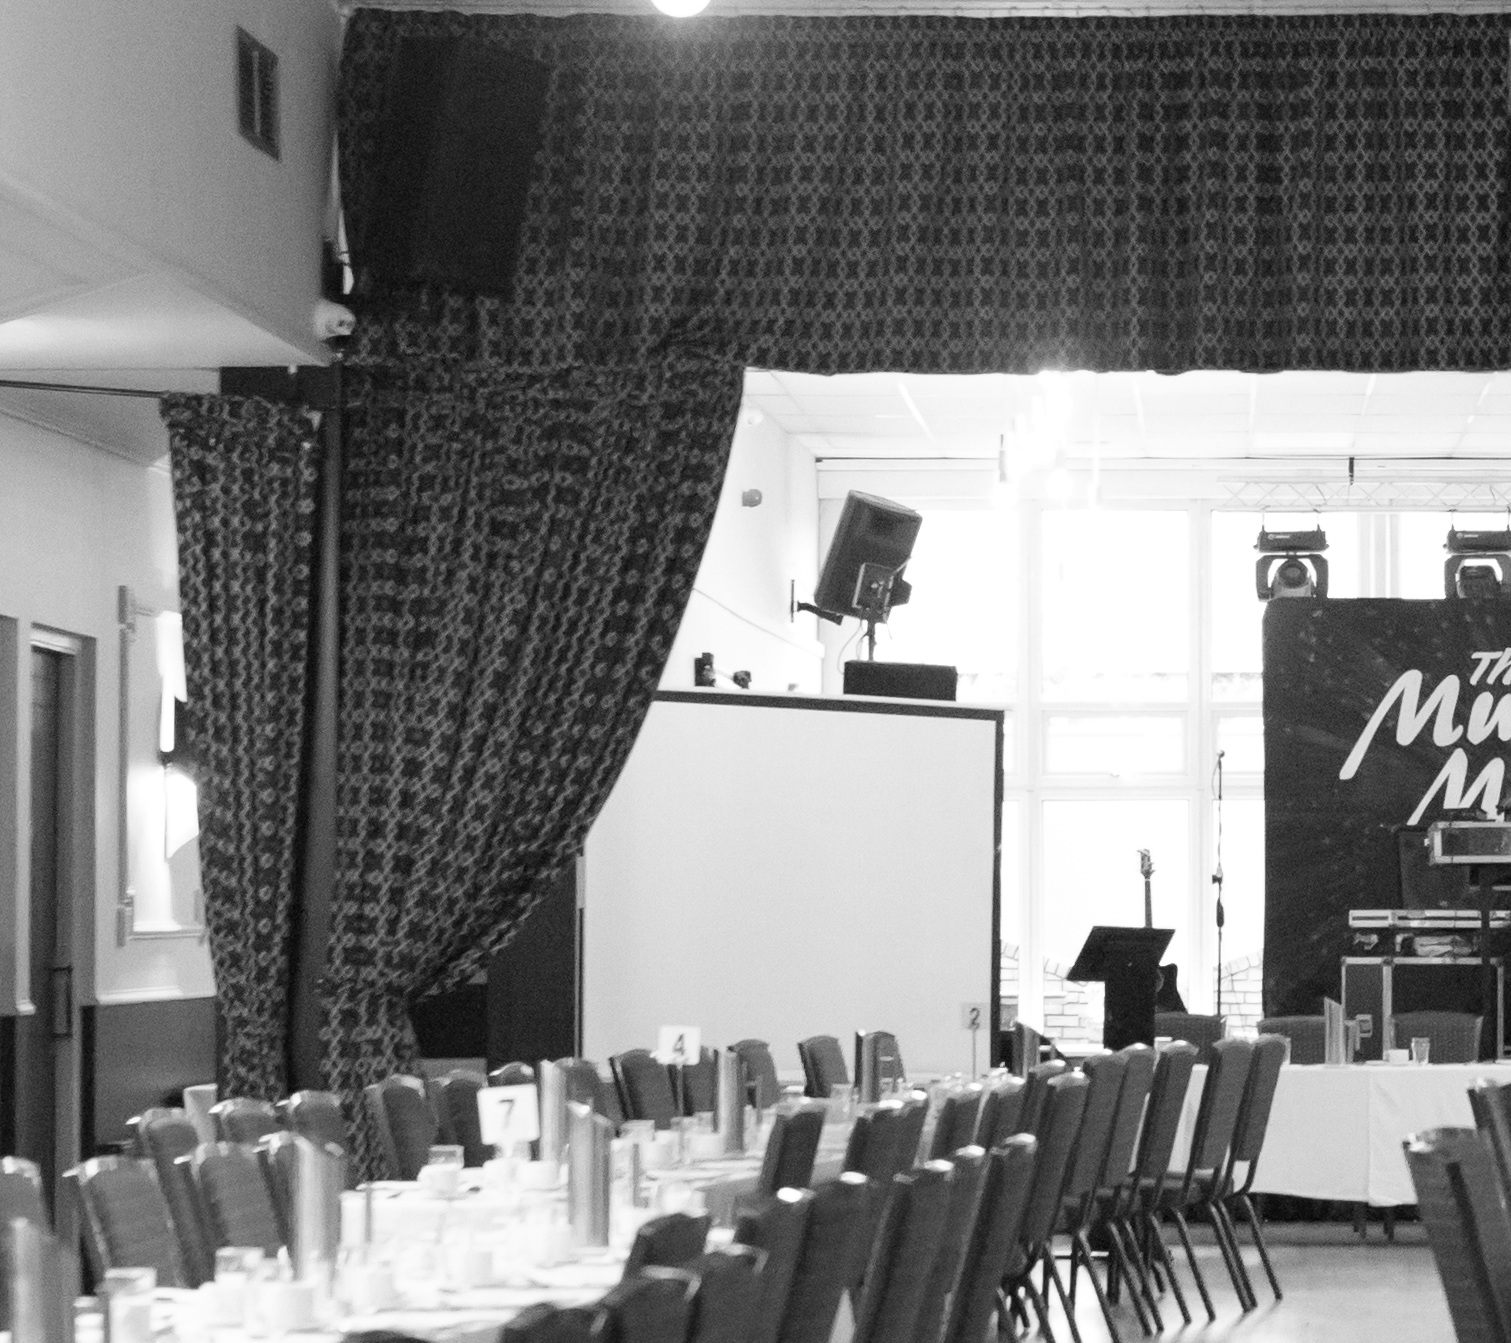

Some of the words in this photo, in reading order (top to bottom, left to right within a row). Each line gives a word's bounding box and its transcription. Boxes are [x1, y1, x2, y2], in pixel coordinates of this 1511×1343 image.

[969, 1007, 981, 1028] 2
[671, 1032, 686, 1056] 4
[498, 1097, 516, 1130] 7
